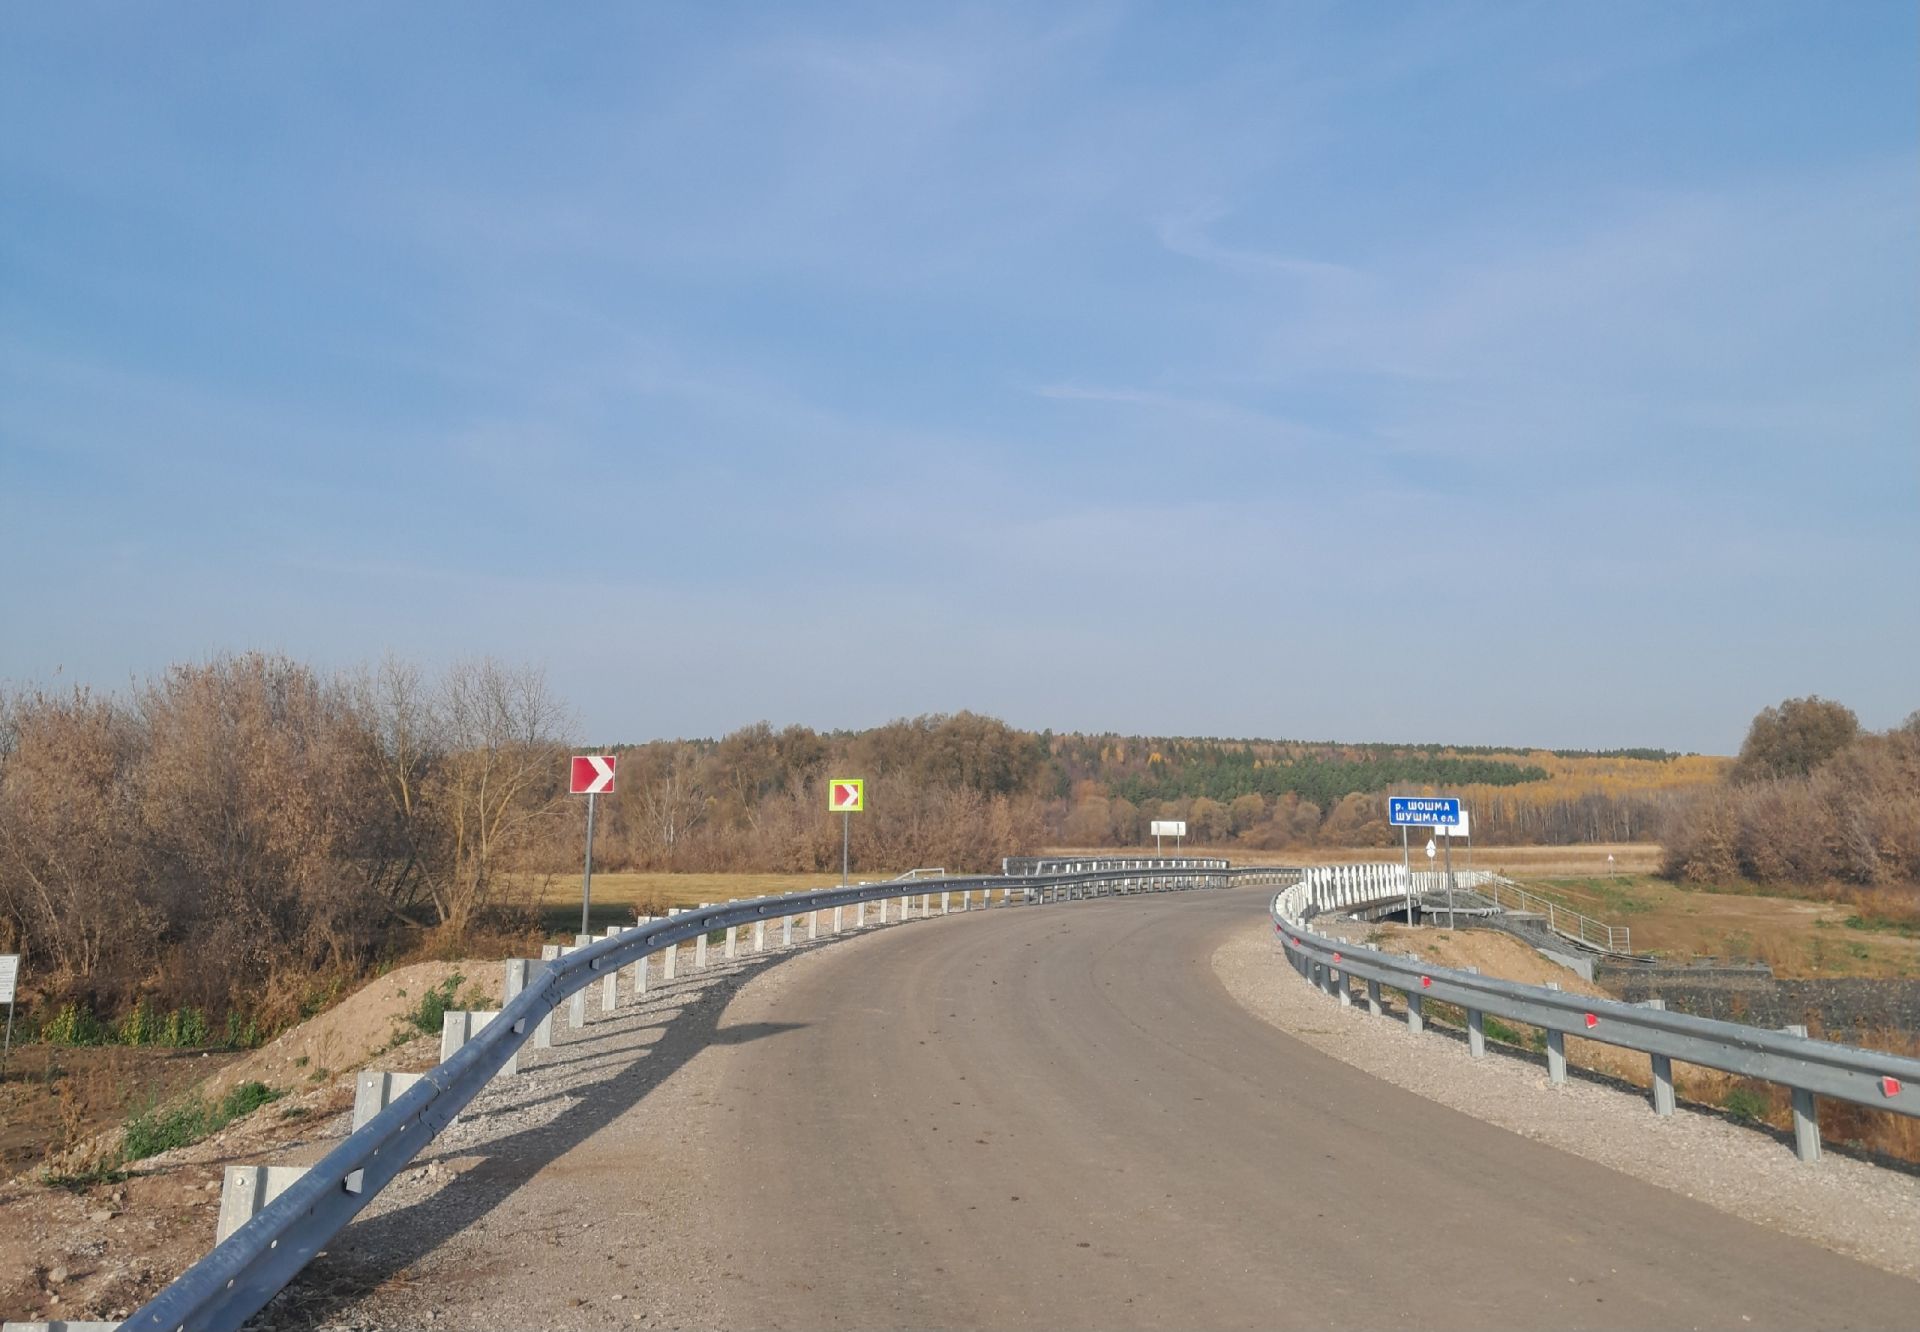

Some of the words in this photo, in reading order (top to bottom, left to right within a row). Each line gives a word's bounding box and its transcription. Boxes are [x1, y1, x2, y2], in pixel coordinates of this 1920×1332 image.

[1395, 803, 1404, 811] р.
[1407, 801, 1450, 811] ШОШМА
[1395, 812, 1439, 822] ШУШМА
[1440, 814, 1456, 823] ел.
